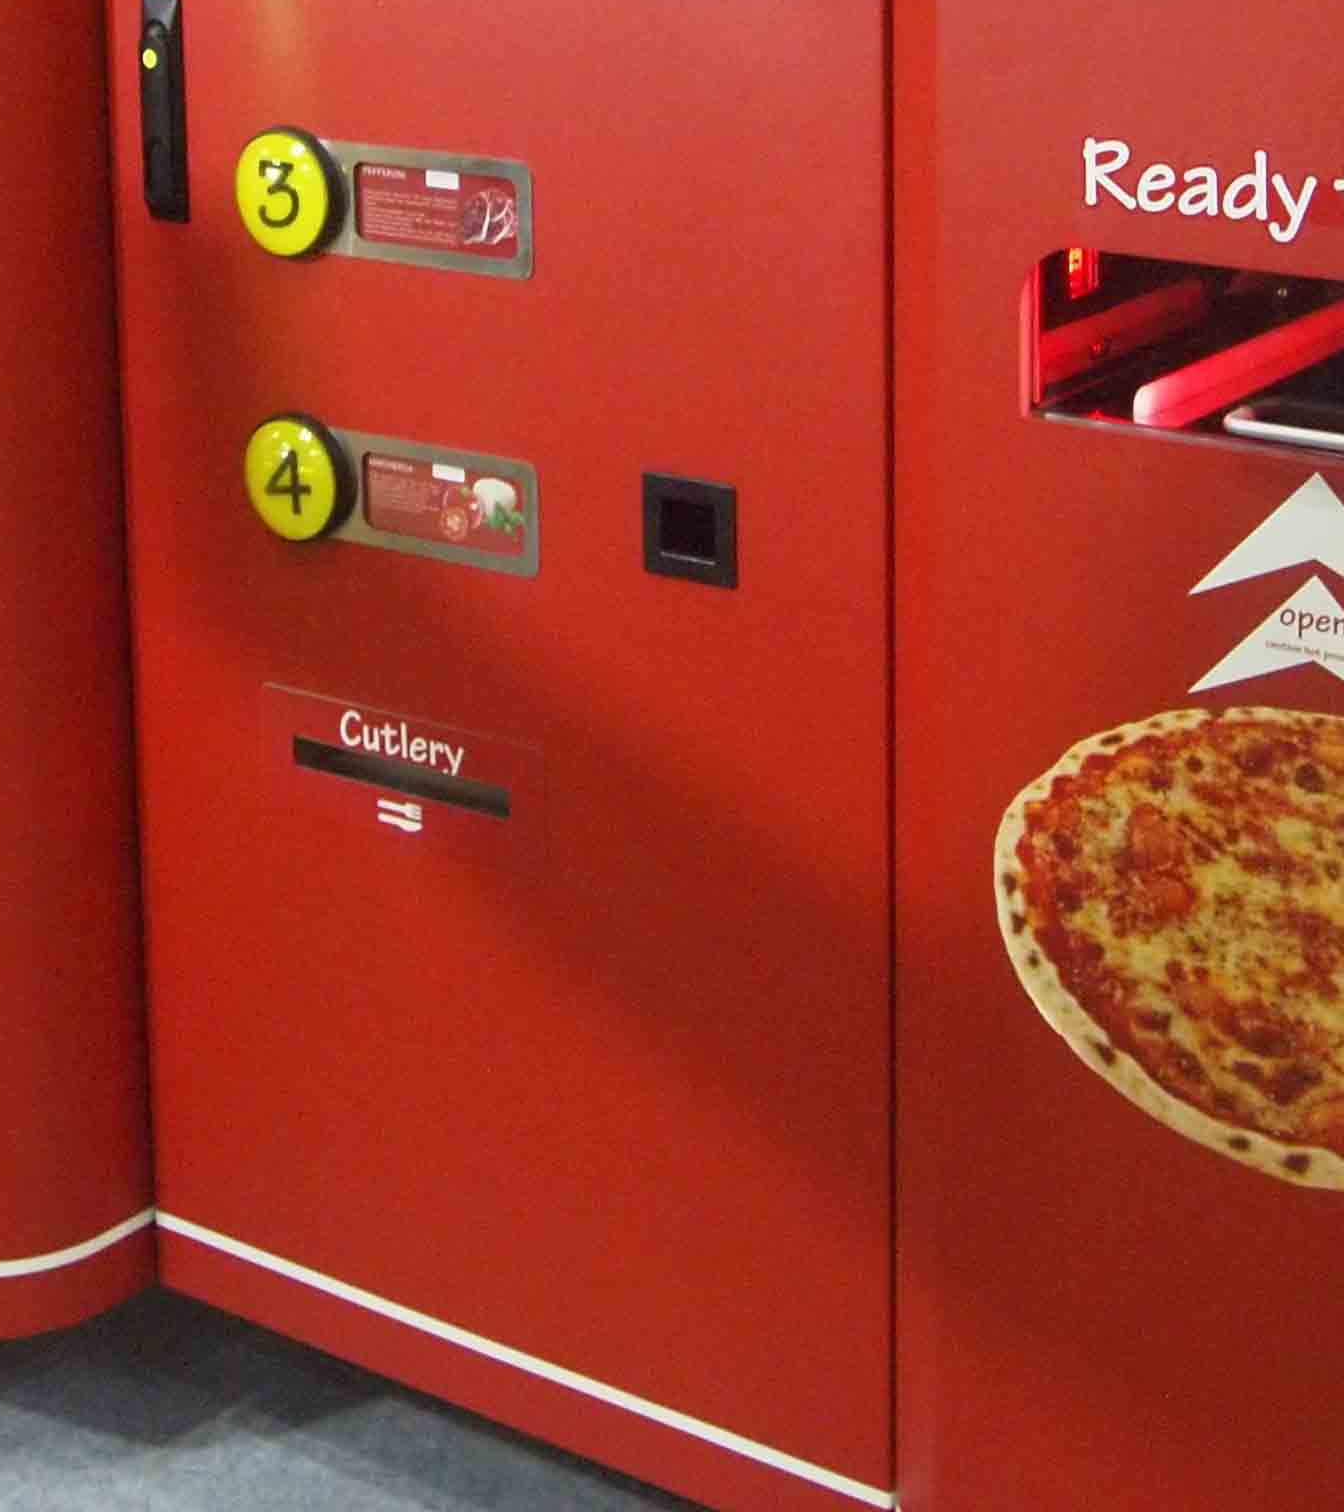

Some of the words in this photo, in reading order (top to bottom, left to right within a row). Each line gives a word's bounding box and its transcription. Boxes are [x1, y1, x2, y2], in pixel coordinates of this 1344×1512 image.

[257, 159, 301, 228] 3
[1083, 137, 1317, 243] Ready
[264, 449, 311, 516] 4
[339, 709, 464, 776] Cutlery
